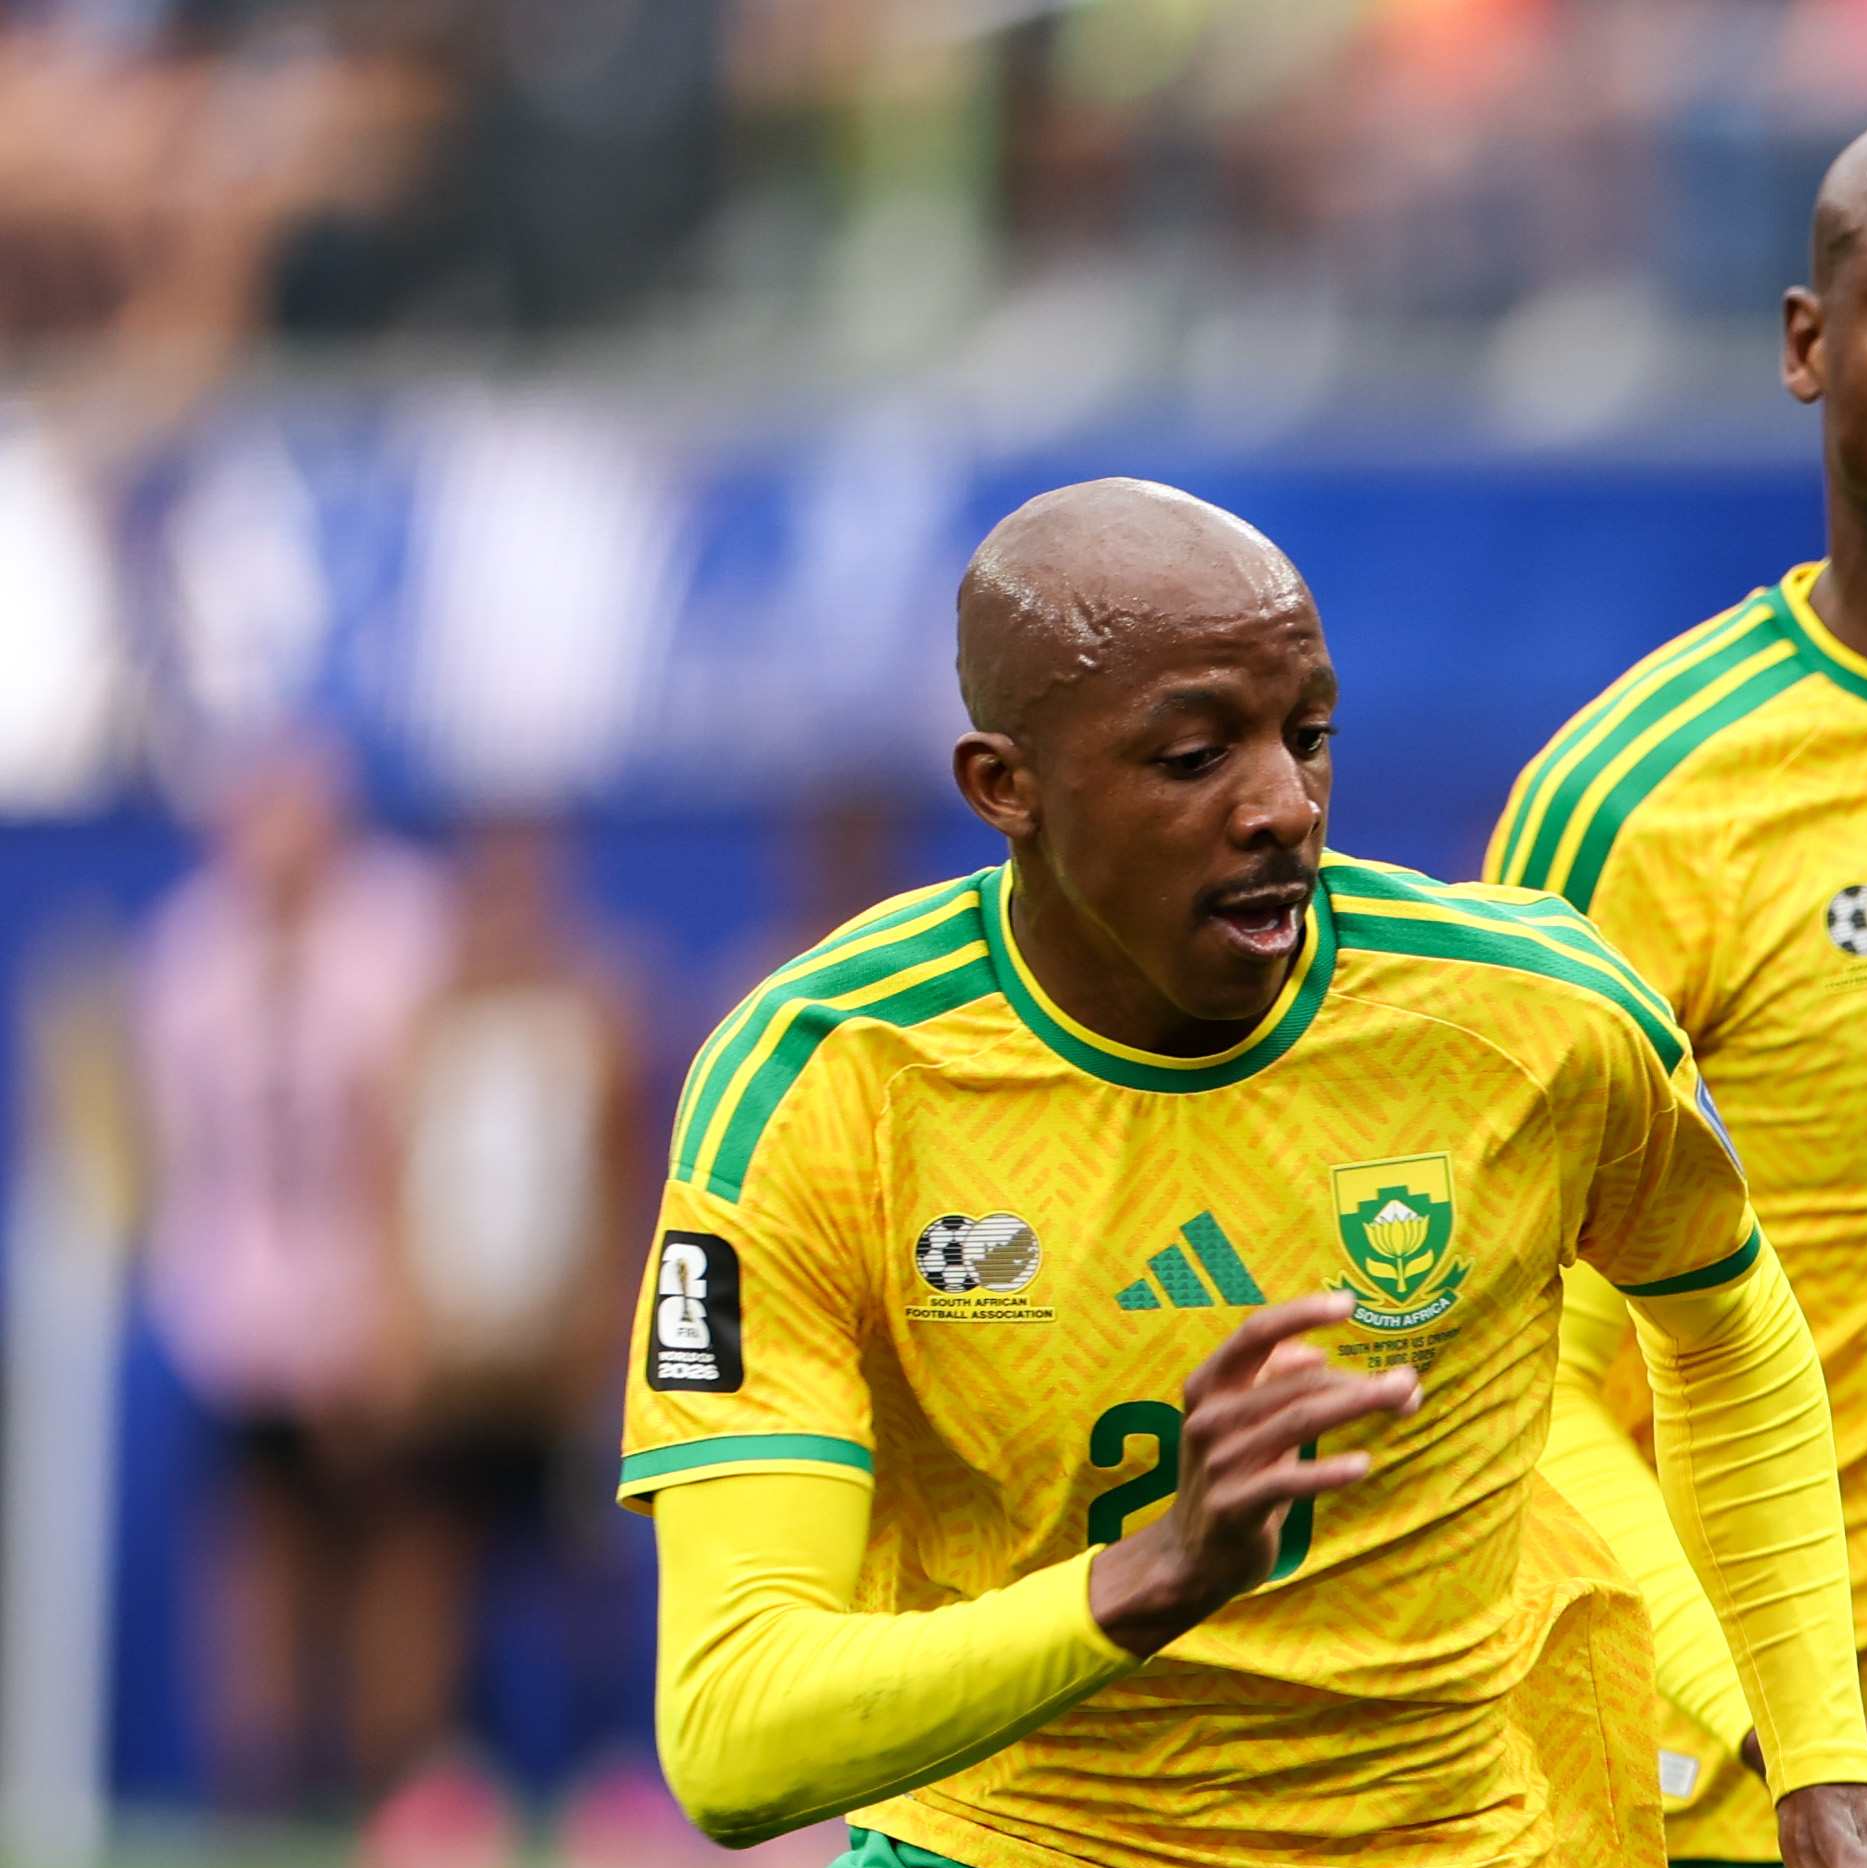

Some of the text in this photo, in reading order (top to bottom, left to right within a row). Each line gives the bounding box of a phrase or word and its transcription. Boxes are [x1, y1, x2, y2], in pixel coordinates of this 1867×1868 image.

[930, 1297, 1028, 1307] SOUTH AFRICAN
[905, 1308, 1053, 1319] FOOTBALL ASSOCIATION
[1354, 1297, 1451, 1327] SOUTH AFRICA
[658, 1362, 720, 1381] 2026
[1088, 1400, 1318, 1583] 2
